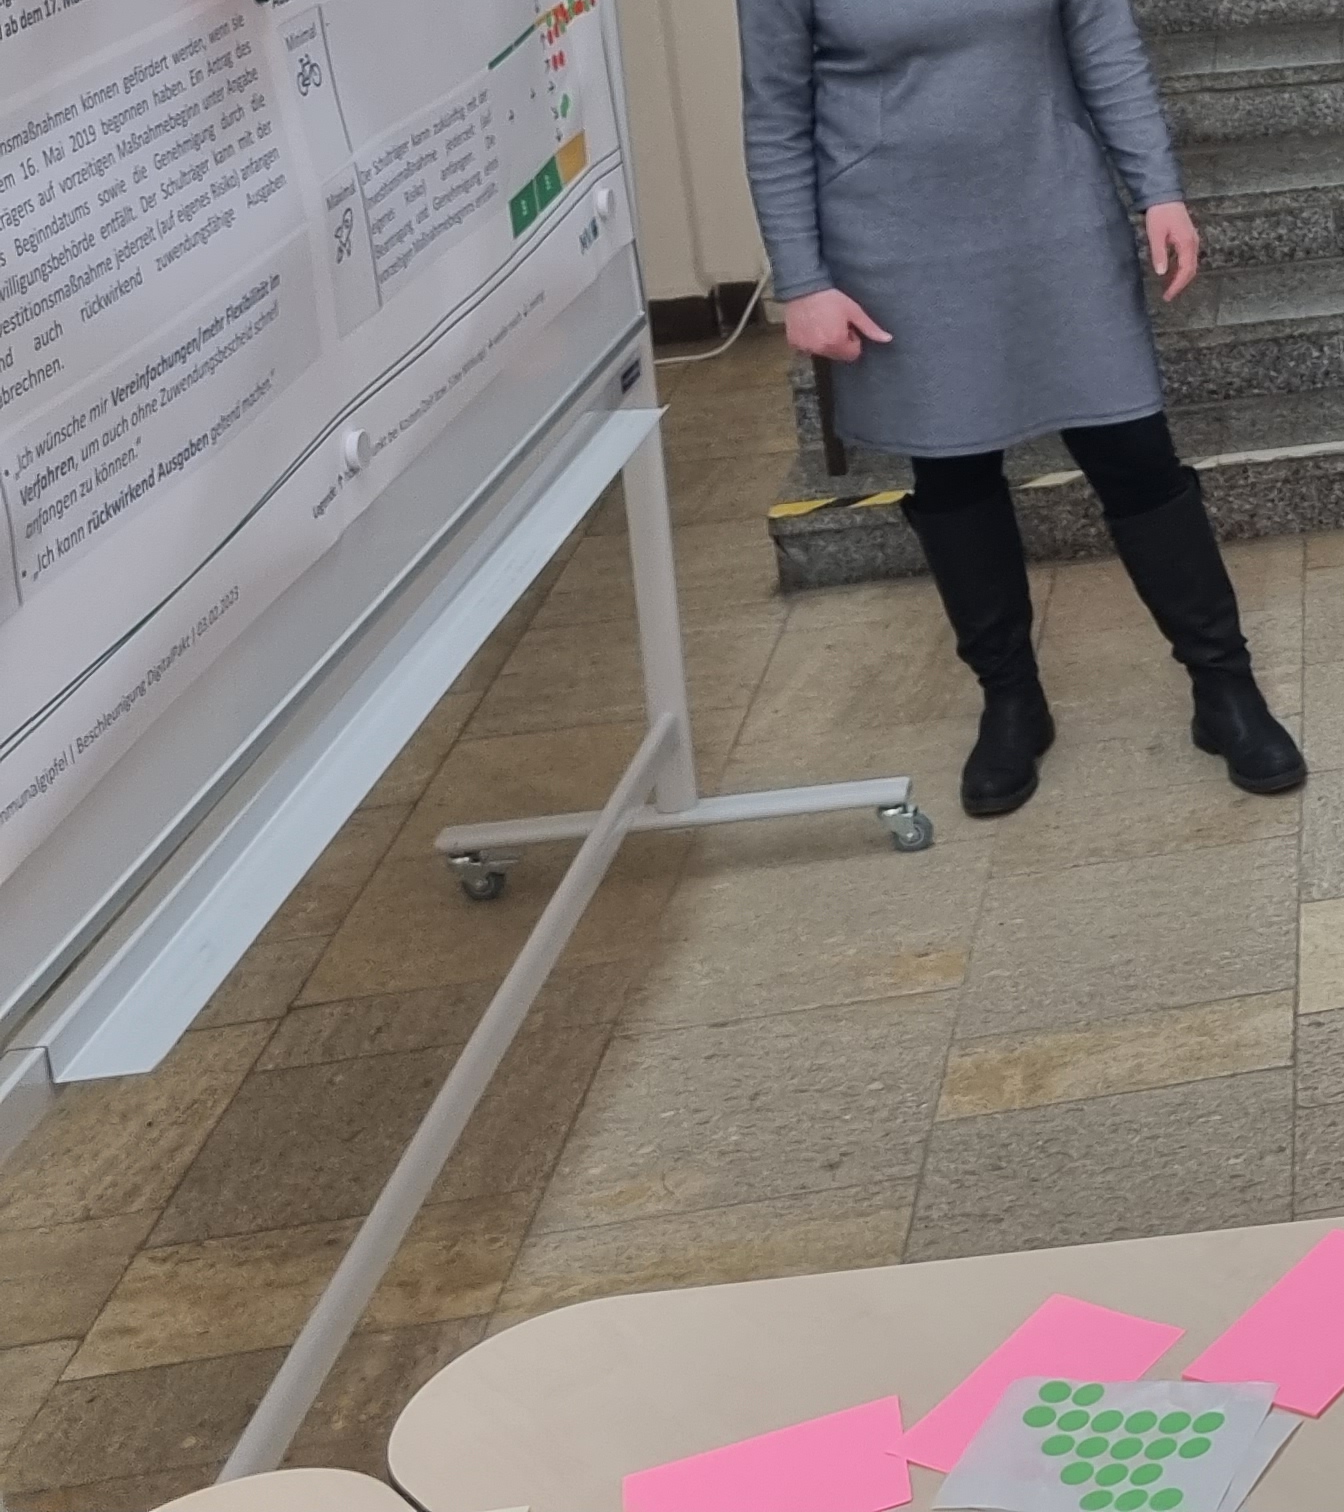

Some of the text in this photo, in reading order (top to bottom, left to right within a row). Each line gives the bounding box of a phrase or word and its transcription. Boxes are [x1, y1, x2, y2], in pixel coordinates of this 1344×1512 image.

[5, 13, 19, 38] ab
[20, 6, 44, 31] dem
[19, 156, 40, 182] 16.
[42, 141, 66, 169] Mai
[70, 124, 98, 154] 2019
[101, 99, 149, 136] begonnen
[152, 79, 187, 107] haben.
[80, 80, 120, 111] können
[122, 54, 170, 95] gefördert
[14, 200, 92, 258] Beginndatums
[96, 178, 128, 208] sowie
[132, 163, 149, 185] die
[152, 123, 216, 172] Genehmigung
[219, 102, 246, 130] durch
[37, 180, 57, 208] auf
[58, 150, 117, 194] vorzeitigen
[116, 100, 201, 159] Maßnahmebeginn
[99, 205, 139, 241] entfällt.
[139, 191, 158, 214] Der
[160, 158, 210, 200] Schulträger
[213, 143, 236, 166] kann
[114, 225, 158, 271] jederzeit
[157, 207, 176, 241] (auf
[177, 188, 212, 224] eigenes
[33, 319, 65, 352] auch
[80, 266, 144, 323] rückwirkend
[19, 454, 79, 507] Verfahren,
[80, 437, 100, 463] um
[102, 415, 130, 449] auch
[131, 398, 159, 428] ohne
[36, 409, 87, 460] wünsche
[89, 397, 109, 423] mir
[25, 488, 78, 540] anfangen
[79, 476, 94, 499] zu
[55, 524, 86, 558] kann
[86, 469, 156, 536] rückwirkend
[156, 431, 210, 482] Ausgaben
[76, 679, 147, 756] Beschleunigung
[147, 634, 192, 687] DigitalPakt
